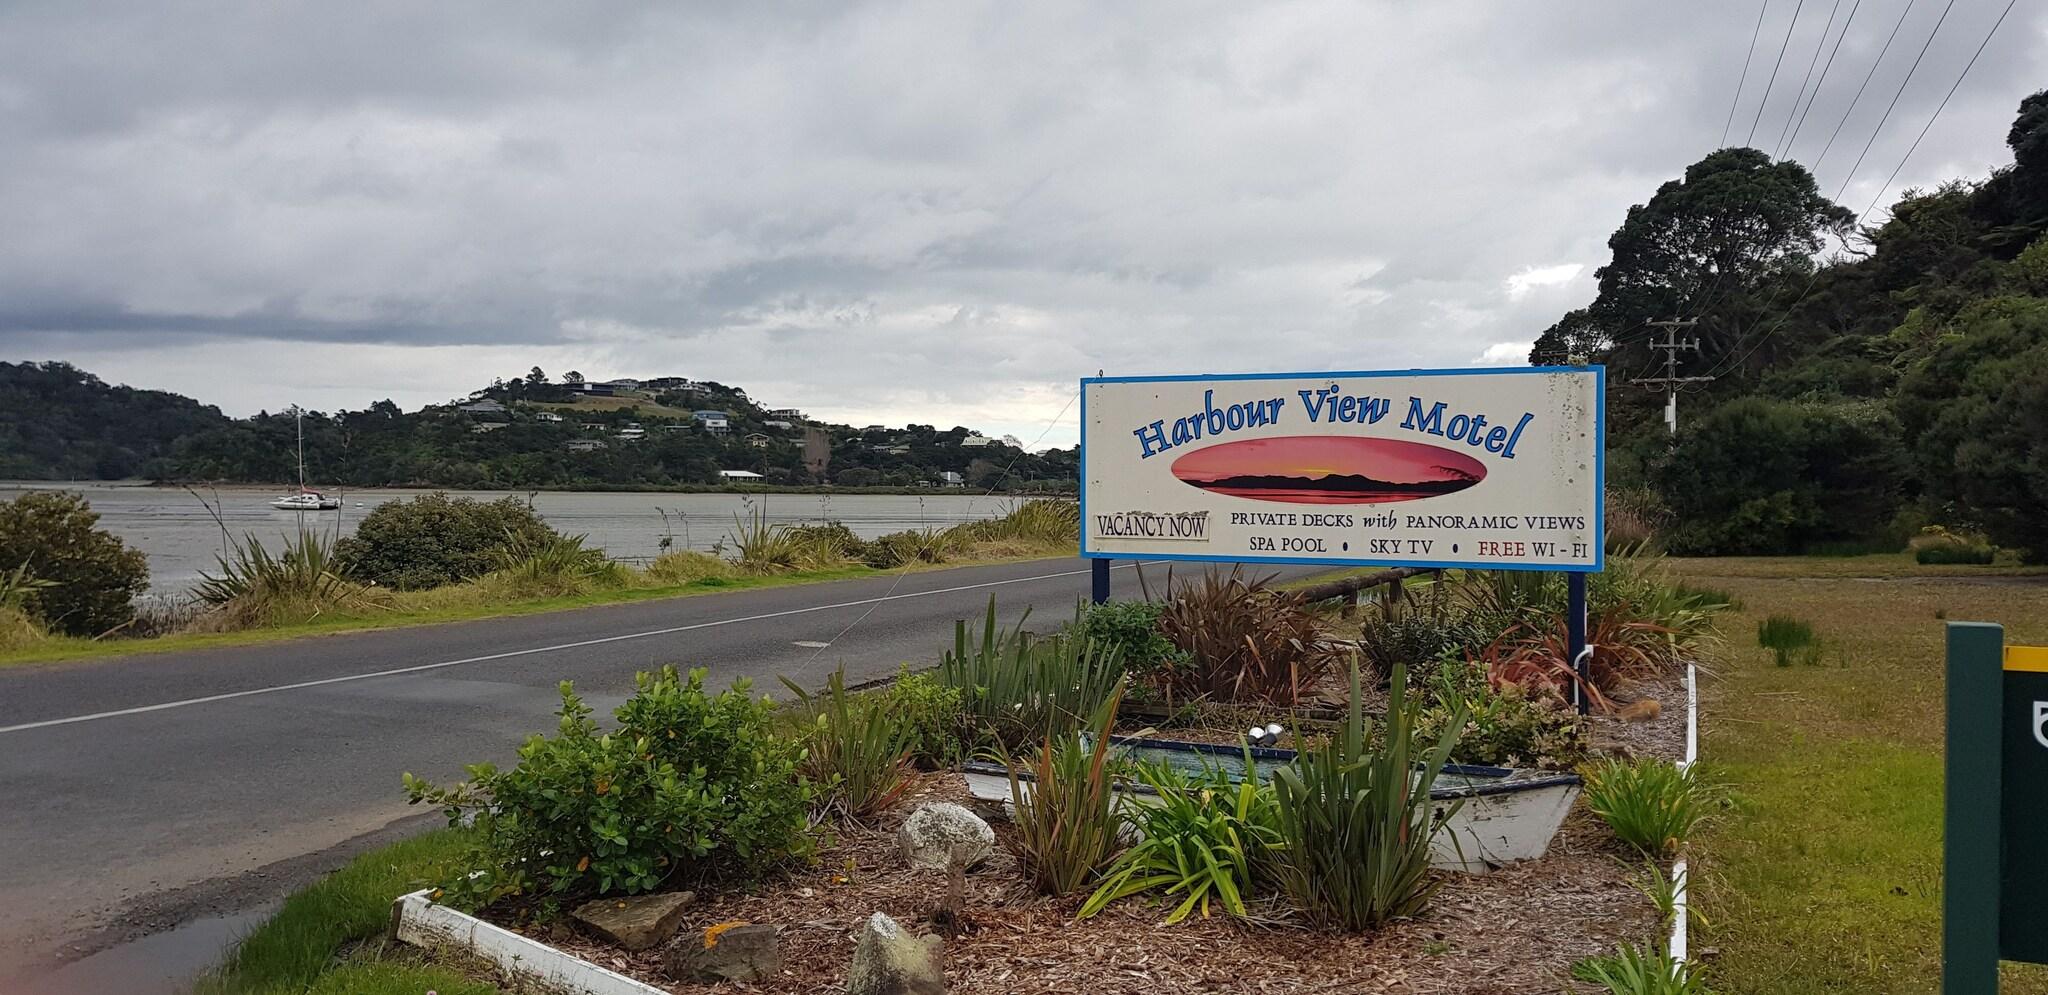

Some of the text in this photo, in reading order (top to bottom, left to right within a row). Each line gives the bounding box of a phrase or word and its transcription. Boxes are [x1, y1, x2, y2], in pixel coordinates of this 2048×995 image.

[1133, 384, 1534, 459] Harbour View Motel
[1097, 515, 1206, 537] VACANCY NOW
[1231, 510, 1585, 530] PRIVATE DECKS with PANORAMIC VIEWS
[1249, 537, 1276, 551] SPA
[1281, 538, 1327, 552] POOL
[1370, 539, 1401, 554] SKY
[1407, 540, 1434, 554] TV
[1478, 541, 1526, 557] FREE
